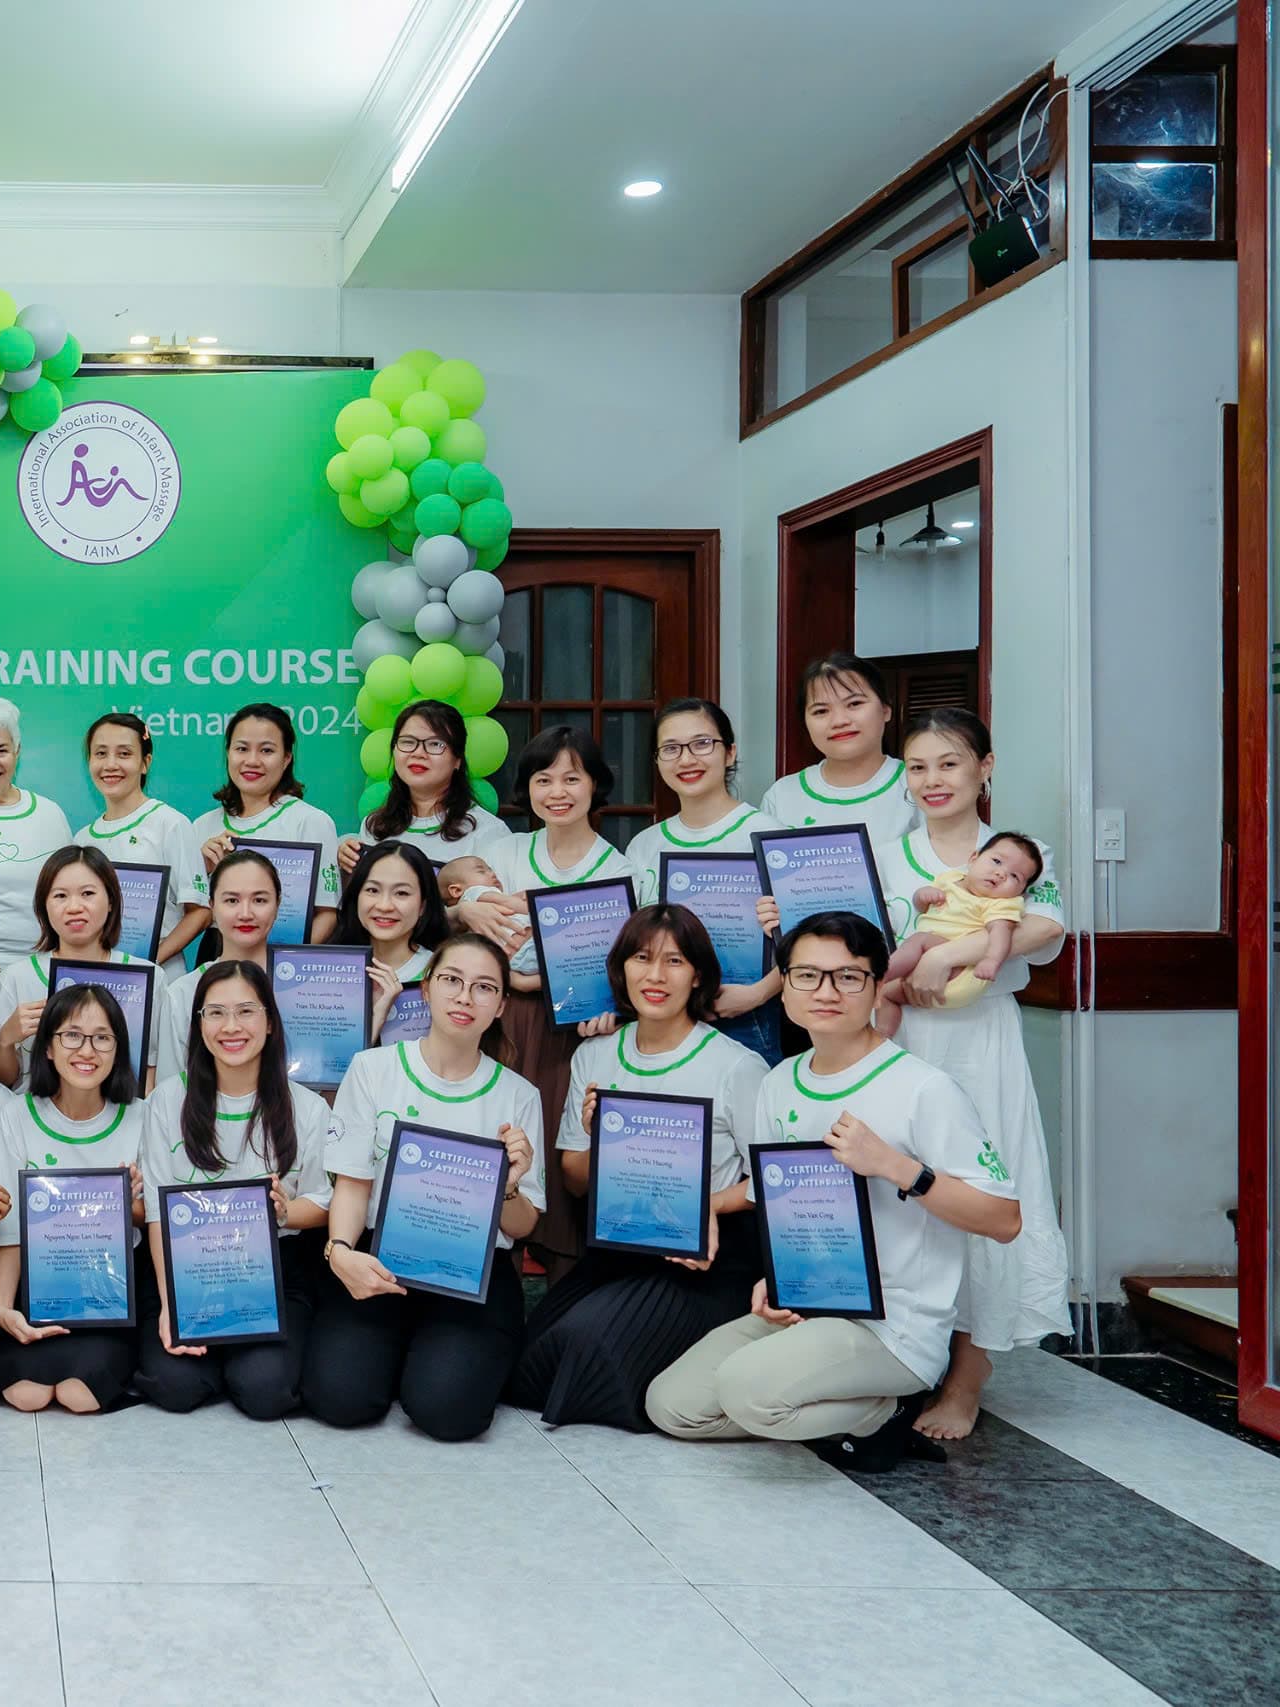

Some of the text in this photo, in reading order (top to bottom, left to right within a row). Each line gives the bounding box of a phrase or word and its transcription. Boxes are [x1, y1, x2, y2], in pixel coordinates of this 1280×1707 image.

[28, 412, 171, 528] International Association of Infant Massage
[84, 545, 120, 557] IAIM
[183, 649, 360, 685] COURSE
[112, 705, 233, 736] etna
[793, 846, 853, 857] CERTIFICATE
[804, 857, 862, 868] ATTENDANCE
[697, 874, 755, 882] CERTIFICATE
[564, 900, 619, 913] CERTIFICATE
[560, 910, 627, 925] OF ATTENDANCE
[302, 964, 356, 973] CERTIFICATE
[309, 976, 363, 984] ATTENDANCE
[631, 1115, 694, 1128] CERTIFICATE
[640, 1129, 701, 1141] ATTENDANCE
[429, 1150, 490, 1170] CERTIFICATE
[420, 1160, 495, 1182] OF ATTENDANCE
[789, 1164, 846, 1174] CERTIFICATE
[784, 1178, 795, 1187] OF
[56, 1192, 114, 1200] CERTIFICATE
[50, 1204, 120, 1212] OF ATTNCE
[193, 1213, 265, 1225] OF ATTENDANCE
